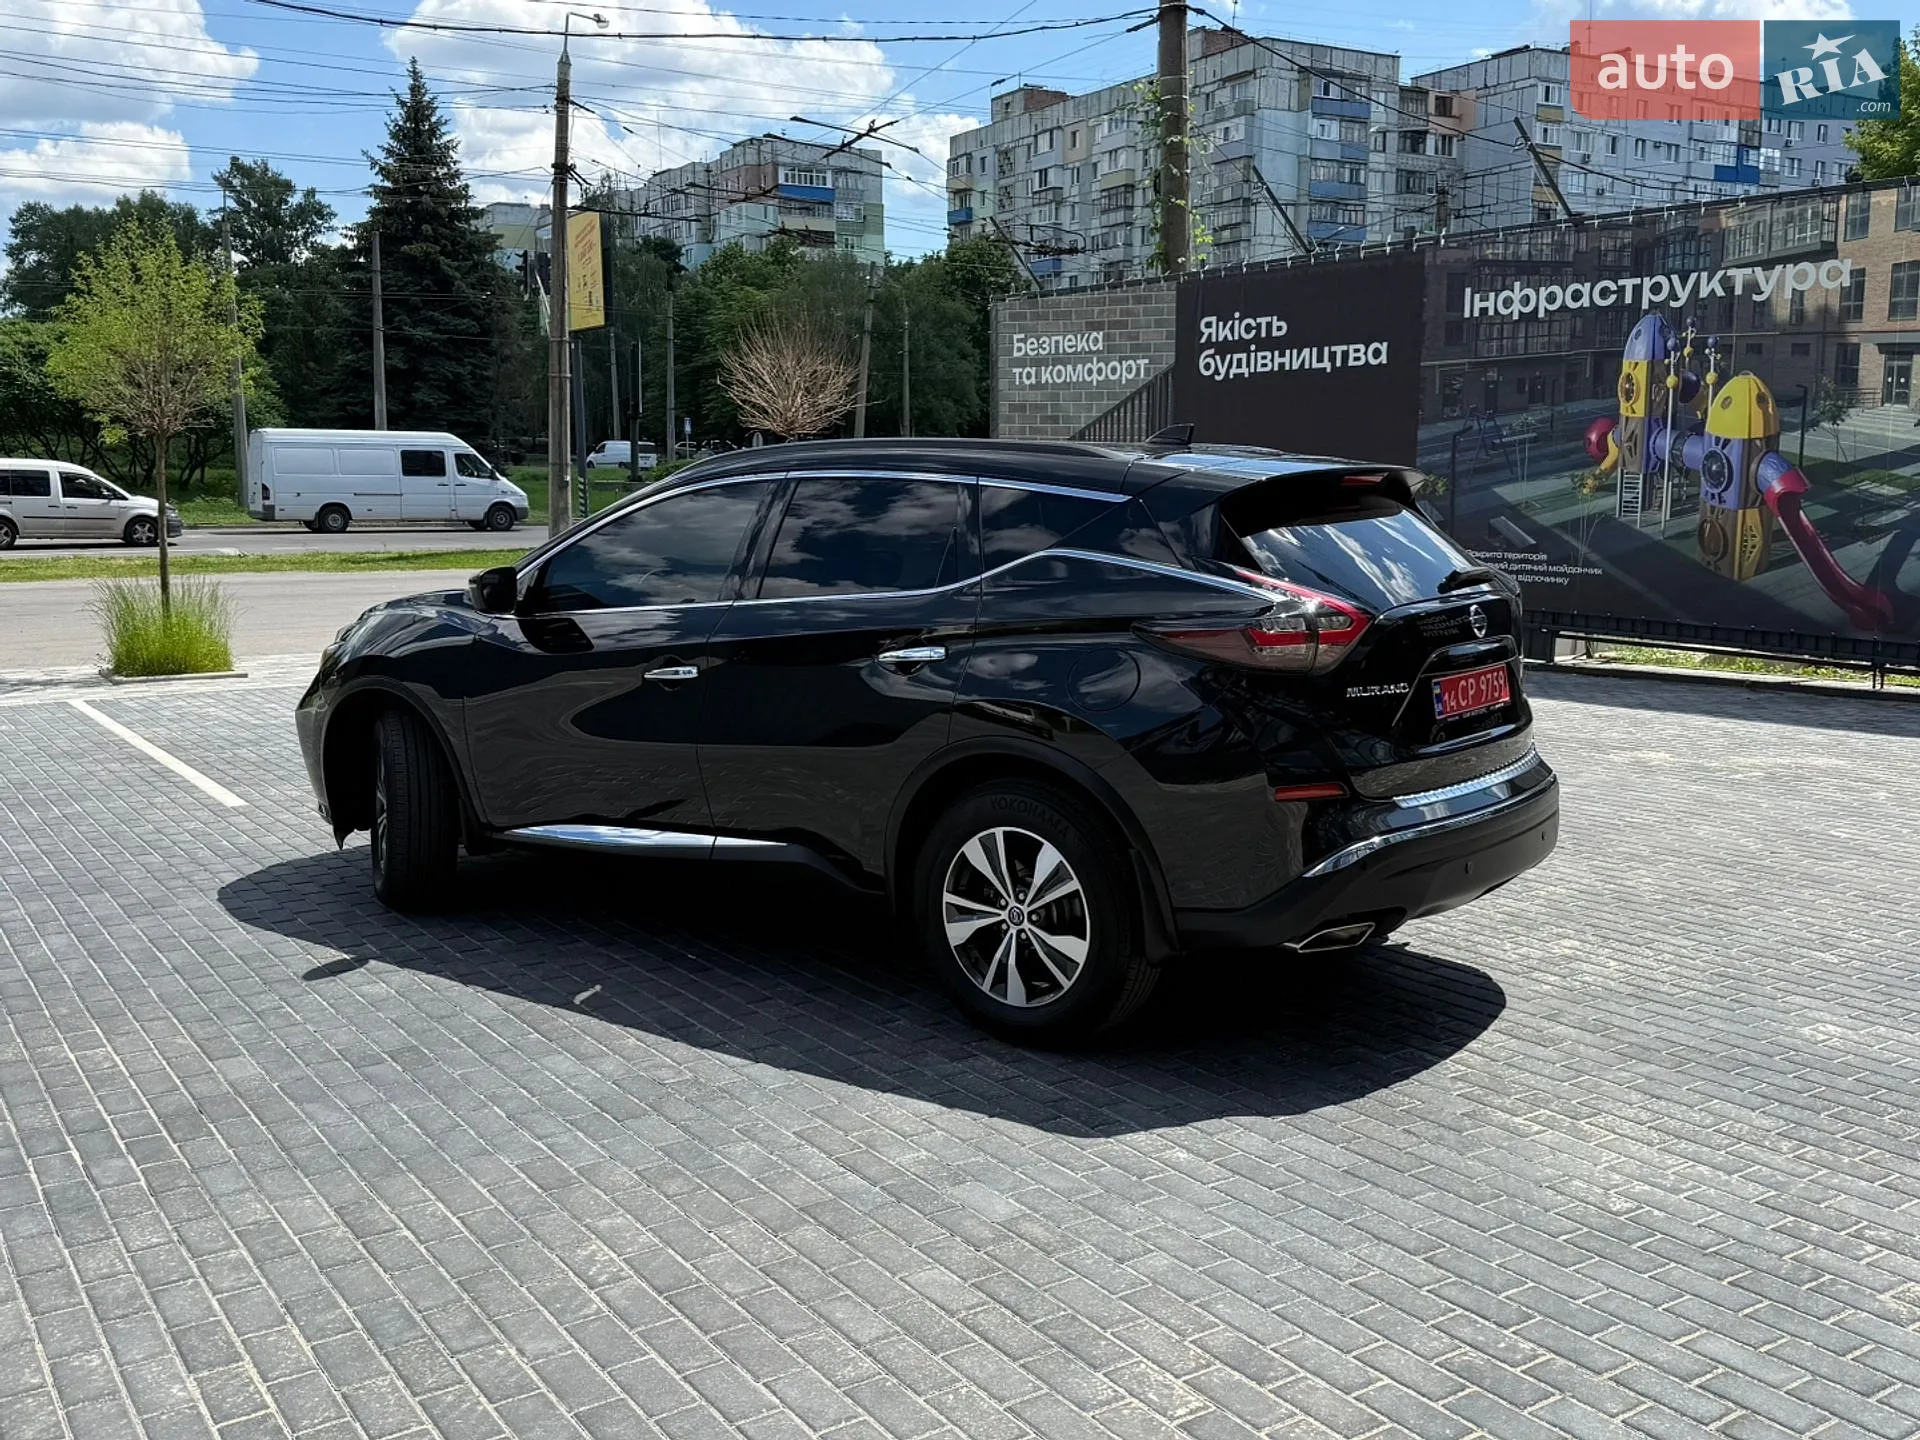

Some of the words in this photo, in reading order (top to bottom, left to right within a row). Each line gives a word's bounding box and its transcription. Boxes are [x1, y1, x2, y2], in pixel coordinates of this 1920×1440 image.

[1463, 257, 1852, 320] Інфраструктура
[1012, 330, 1104, 358] Безпека
[1199, 313, 1288, 344] Якість
[1012, 365, 1036, 385] та
[1040, 356, 1149, 386] комфорт
[1198, 339, 1389, 382] будівництва
[1346, 682, 1410, 698] MURANO
[1443, 689, 1457, 713] 14
[1458, 677, 1476, 707] CP
[1479, 670, 1505, 703] 9759
[990, 796, 1069, 838] YOKOHAMA
